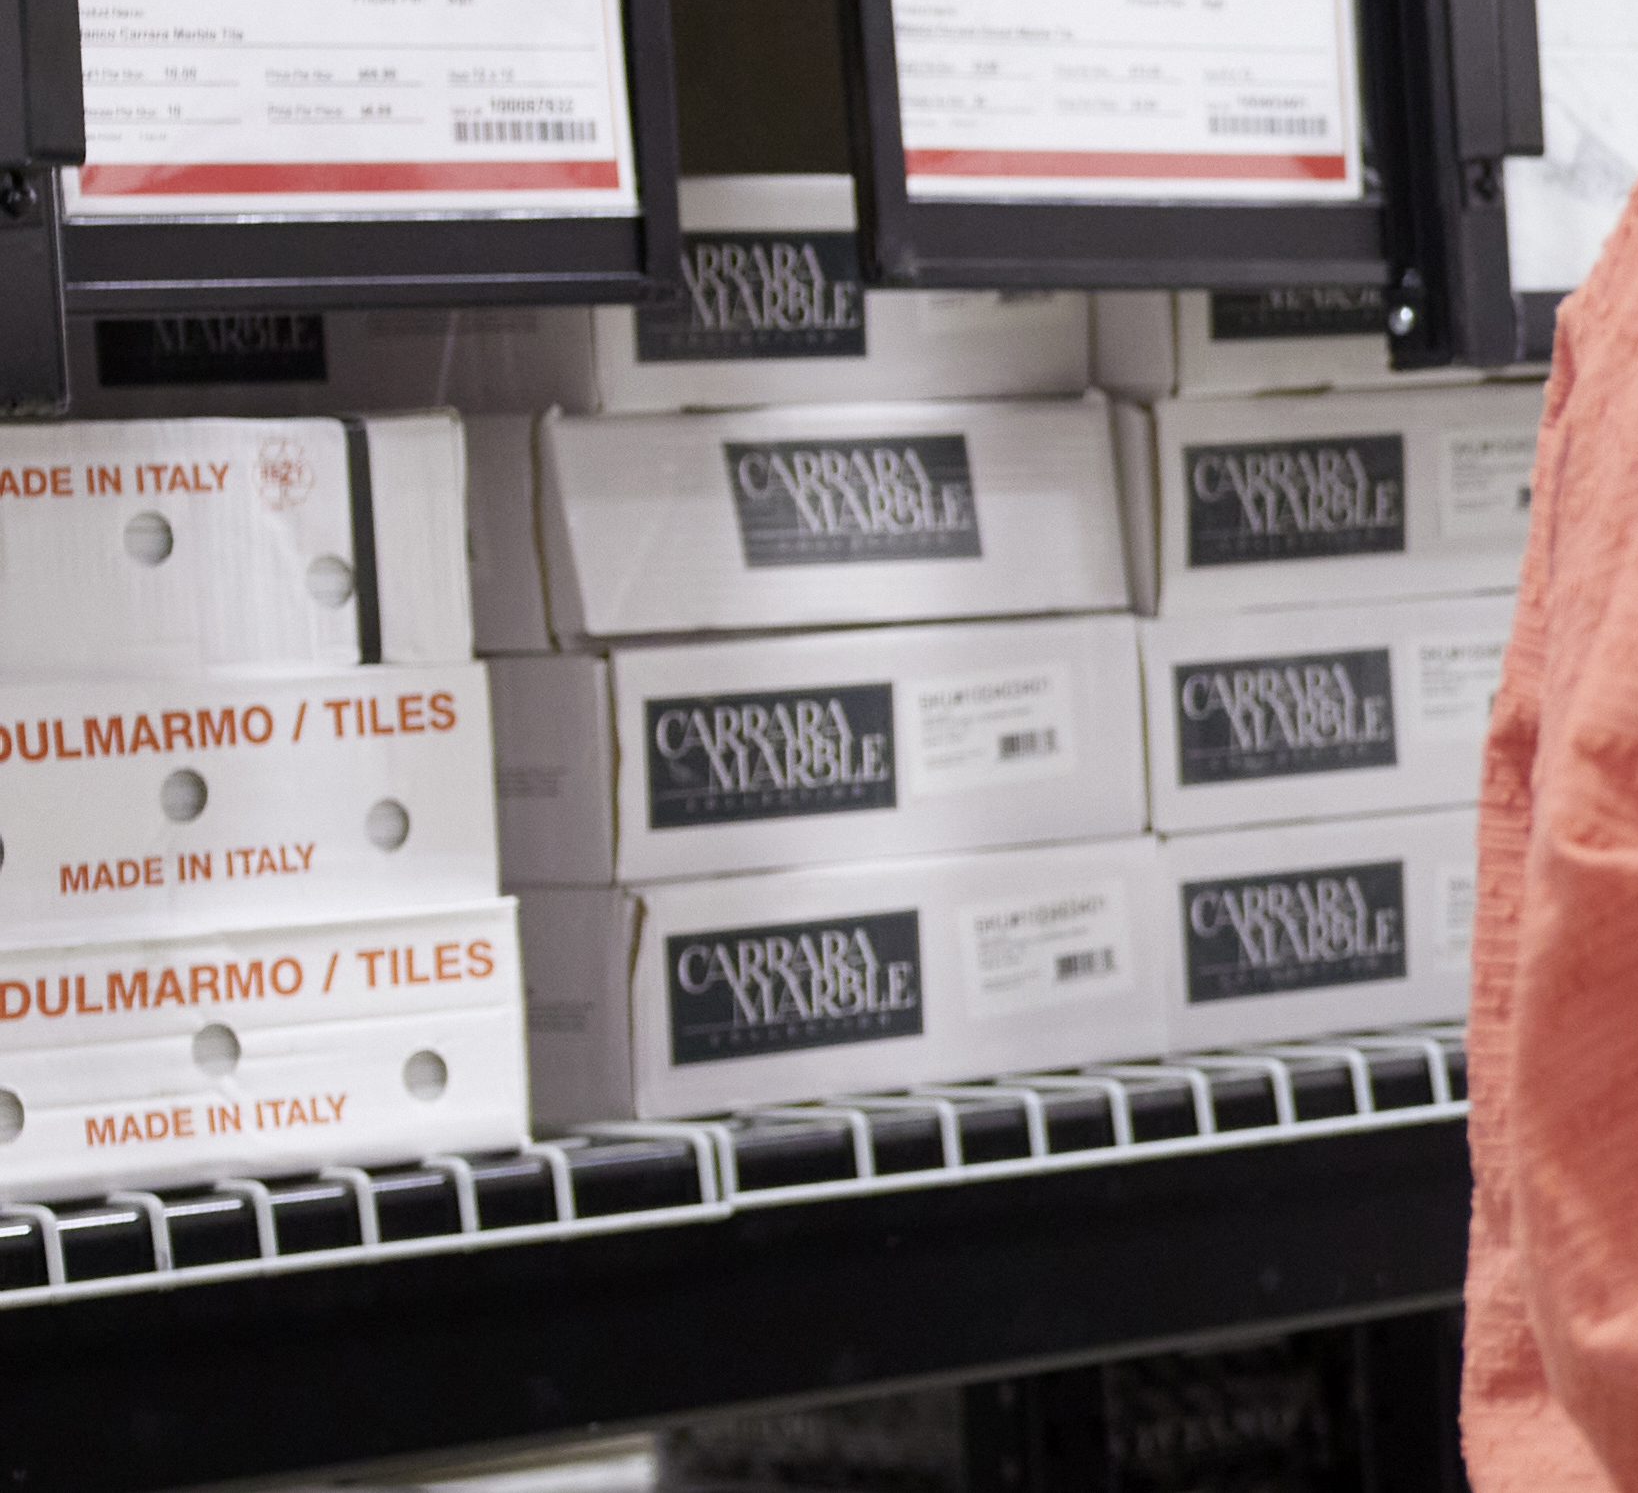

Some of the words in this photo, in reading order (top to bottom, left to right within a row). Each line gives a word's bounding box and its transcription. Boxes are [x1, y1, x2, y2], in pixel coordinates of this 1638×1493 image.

[680, 242, 824, 290] ARRARA
[692, 278, 862, 331] MARBLE
[0, 464, 74, 498] ADE
[86, 463, 122, 496] IN
[136, 462, 229, 495] ITALY
[739, 448, 931, 500] CARRARA
[1194, 448, 1369, 503] CARRARA
[797, 482, 970, 536] MARBLE
[1239, 479, 1399, 534] MARBLE
[323, 690, 458, 739] TILES
[1182, 662, 1356, 722] CARRARA
[656, 697, 853, 760] CARRARA
[1229, 695, 1389, 752] MARBLE
[708, 733, 890, 794] MARBLE
[59, 856, 164, 896] MADE
[178, 851, 213, 883] IN
[225, 842, 315, 880] ITALY
[1190, 875, 1367, 939] CARRARA
[357, 939, 496, 989] TILES
[677, 927, 879, 996] CARRARA
[1237, 909, 1401, 968] MARBLE
[732, 961, 917, 1029] MARBLE
[84, 1108, 193, 1148] MADE
[207, 1104, 243, 1136] IN
[256, 1092, 347, 1130] ITALY
